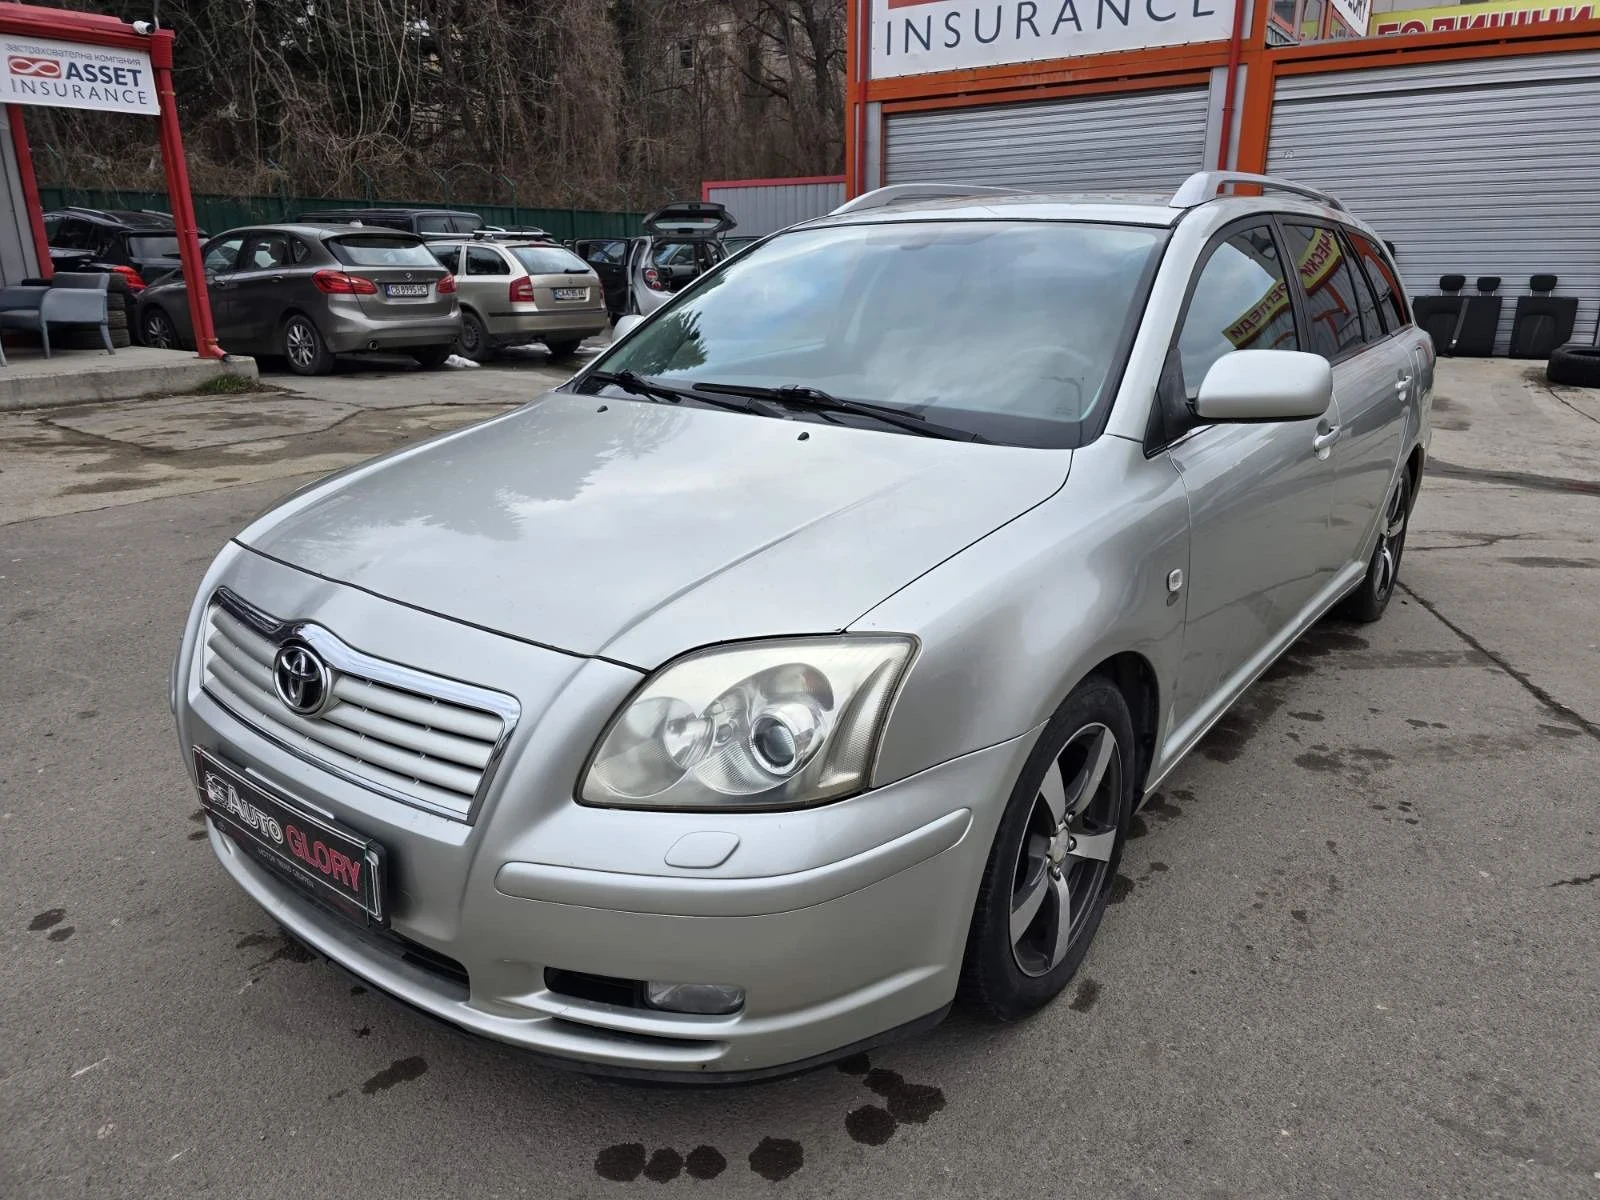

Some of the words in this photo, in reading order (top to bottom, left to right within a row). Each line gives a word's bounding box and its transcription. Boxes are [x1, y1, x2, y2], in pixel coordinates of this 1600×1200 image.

[5, 43, 93, 61] застрахователна
[94, 53, 141, 66] компания
[65, 62, 141, 87] ASSET
[10, 78, 148, 105] INSURANCE
[285, 825, 361, 893] GLORY
